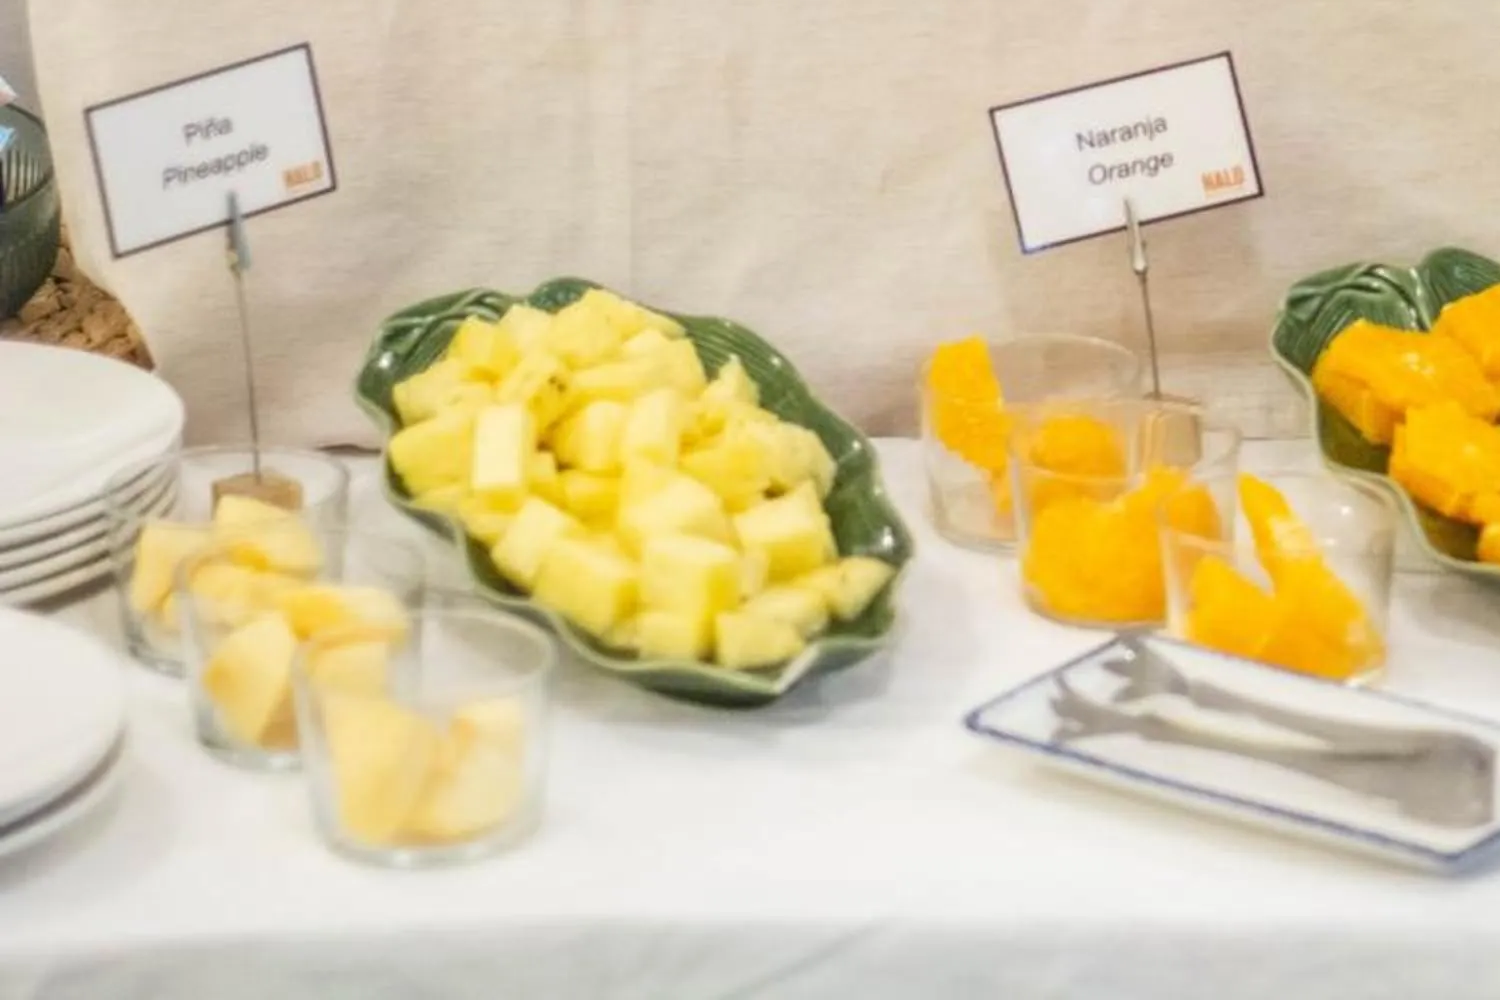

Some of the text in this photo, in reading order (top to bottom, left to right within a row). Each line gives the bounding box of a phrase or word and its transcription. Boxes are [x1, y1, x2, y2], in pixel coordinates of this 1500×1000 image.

[183, 116, 234, 146] Piña
[1075, 114, 1169, 151] Naranja
[161, 143, 269, 191] Pineapple
[1087, 152, 1174, 186] Orange
